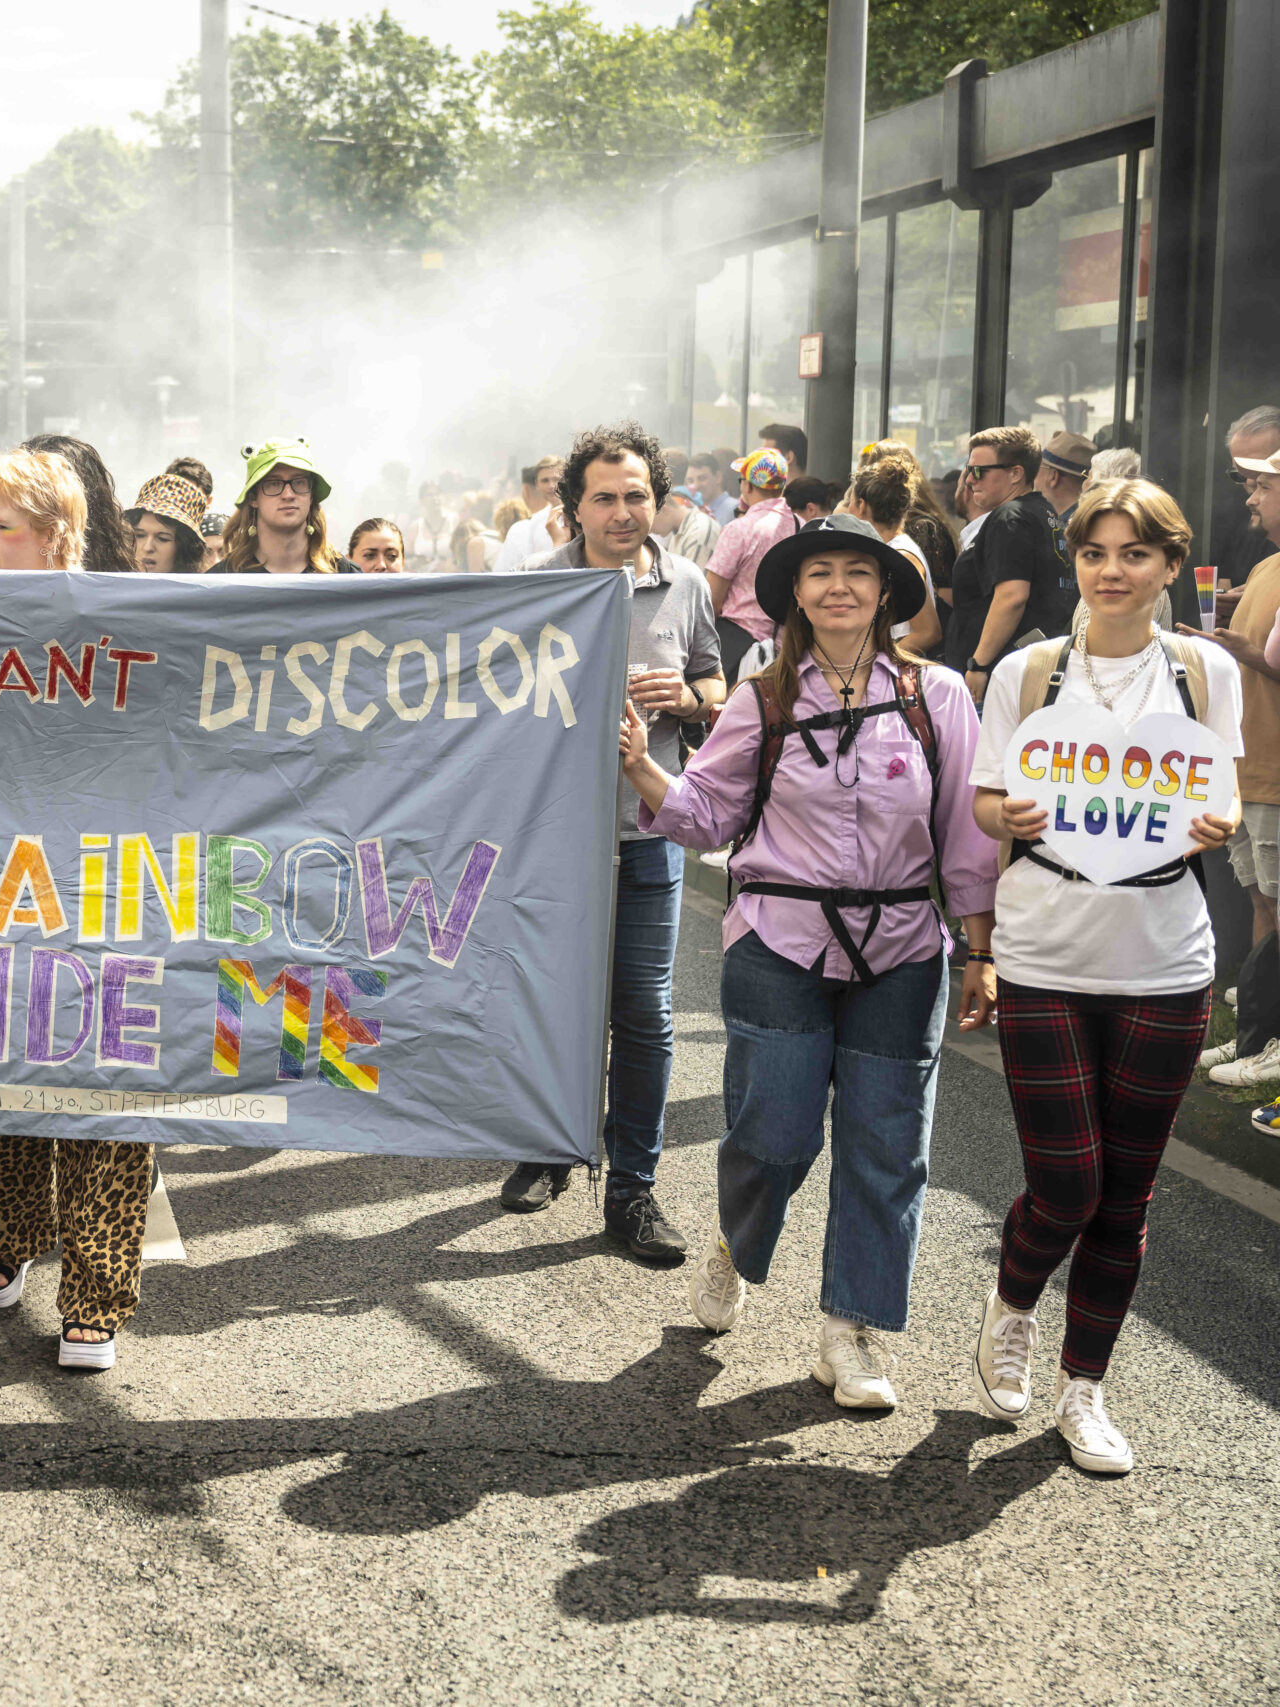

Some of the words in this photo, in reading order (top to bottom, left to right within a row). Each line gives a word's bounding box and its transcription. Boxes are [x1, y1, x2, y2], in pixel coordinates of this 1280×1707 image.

[1020, 739, 1213, 801] CHOOSE
[1055, 795, 1170, 843] LOVE
[211, 959, 388, 1093] ME
[23, 1089, 45, 1111] 21
